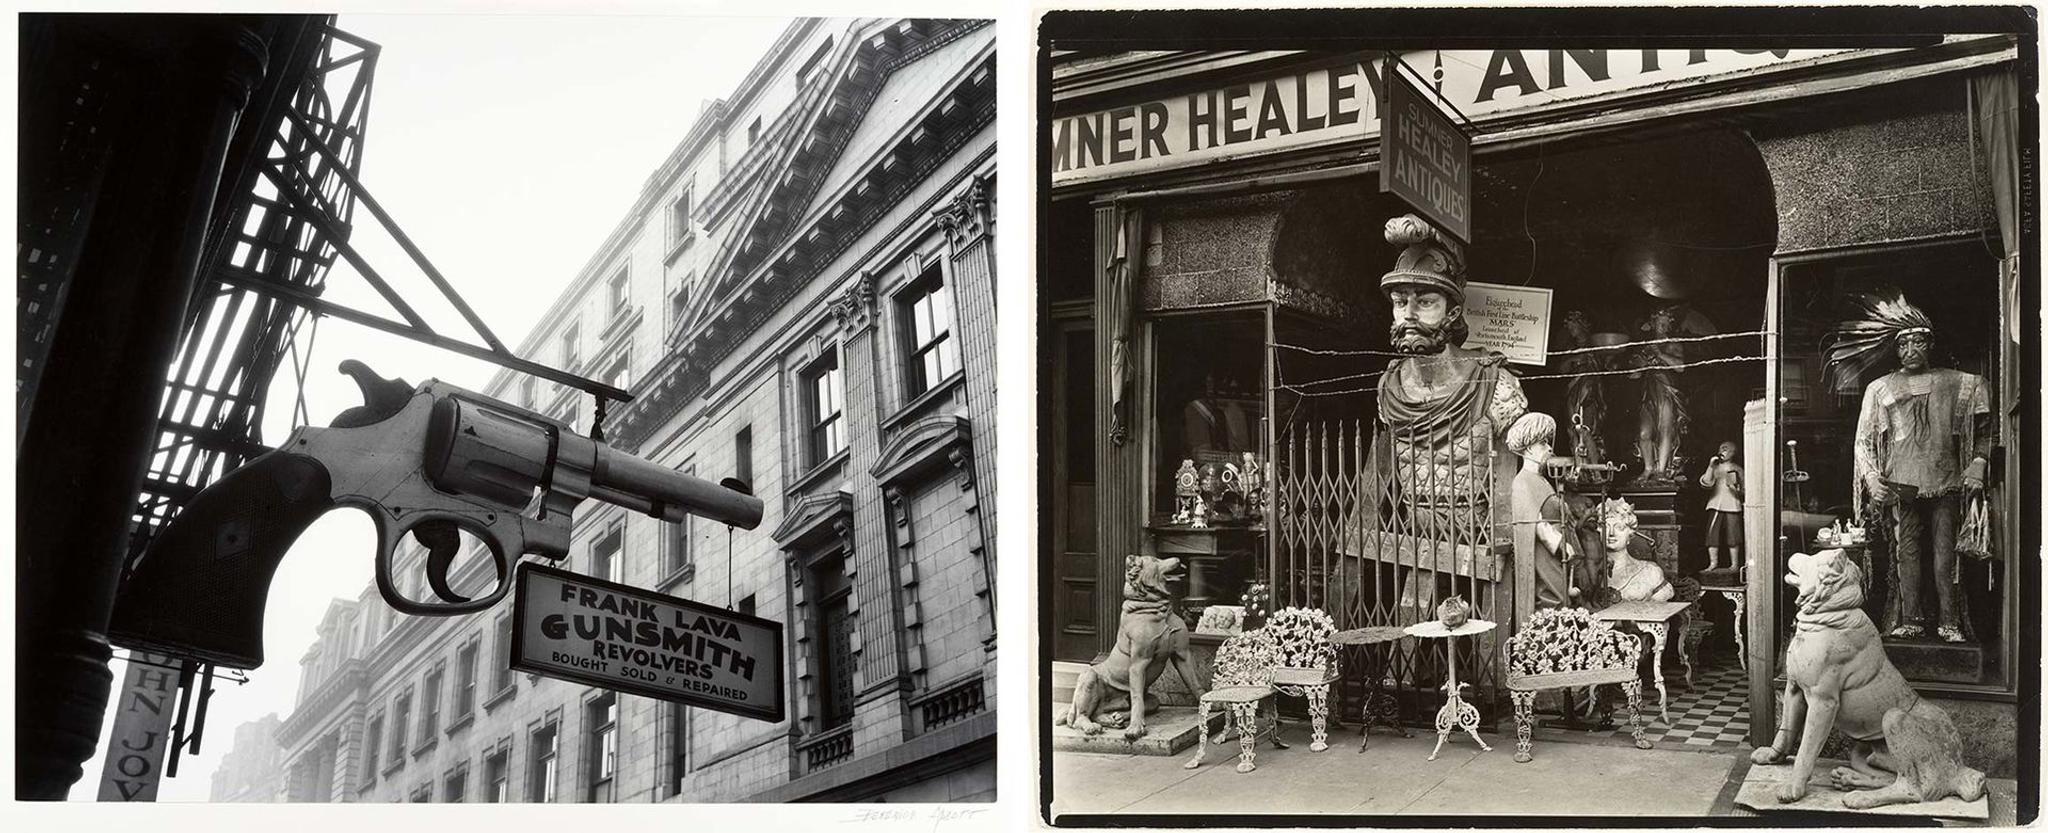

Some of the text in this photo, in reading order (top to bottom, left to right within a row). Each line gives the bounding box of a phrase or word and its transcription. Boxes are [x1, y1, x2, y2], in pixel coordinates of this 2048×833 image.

[1399, 113, 1461, 183] HEALEY
[1408, 102, 1454, 149] SUMNER
[1395, 150, 1464, 223] ANTIQUES
[1489, 319, 1515, 327] MARS
[560, 583, 743, 642] FRANK LAVA
[540, 613, 755, 682] GUNSMITH
[593, 640, 714, 680] REVOLVERS
[552, 651, 609, 673] BOUGHT
[620, 666, 657, 683] SOLD
[682, 679, 748, 701] REPAIRED
